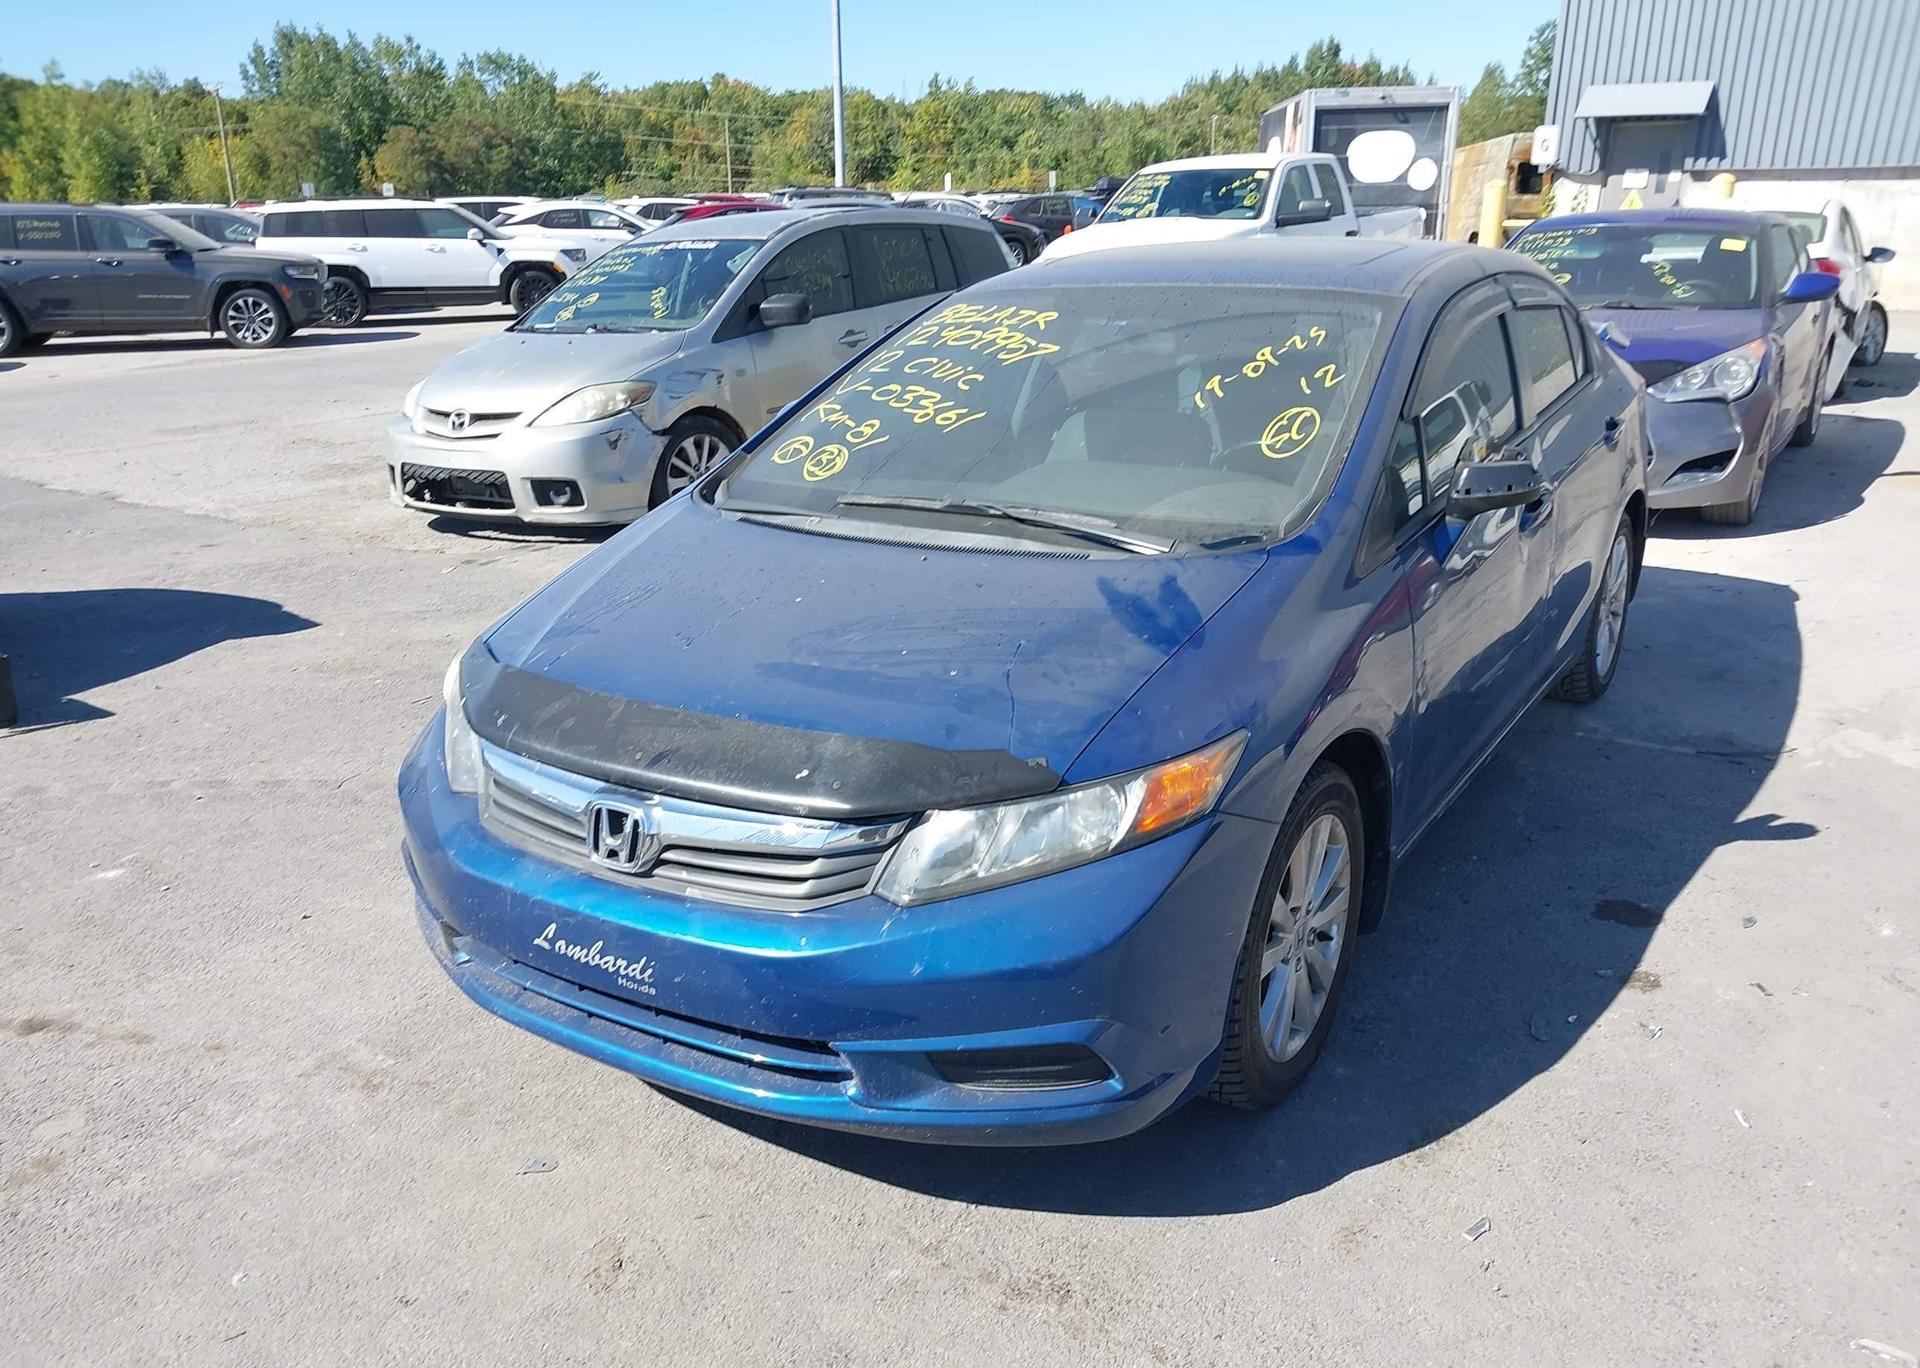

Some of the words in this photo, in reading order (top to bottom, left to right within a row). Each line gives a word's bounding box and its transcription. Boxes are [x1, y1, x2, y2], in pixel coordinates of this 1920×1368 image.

[857, 349, 905, 373] 12
[893, 325, 1061, 367] 12409957
[1300, 363, 1346, 395] 12
[532, 921, 657, 983] Lombardi
[617, 976, 657, 996] Honda
